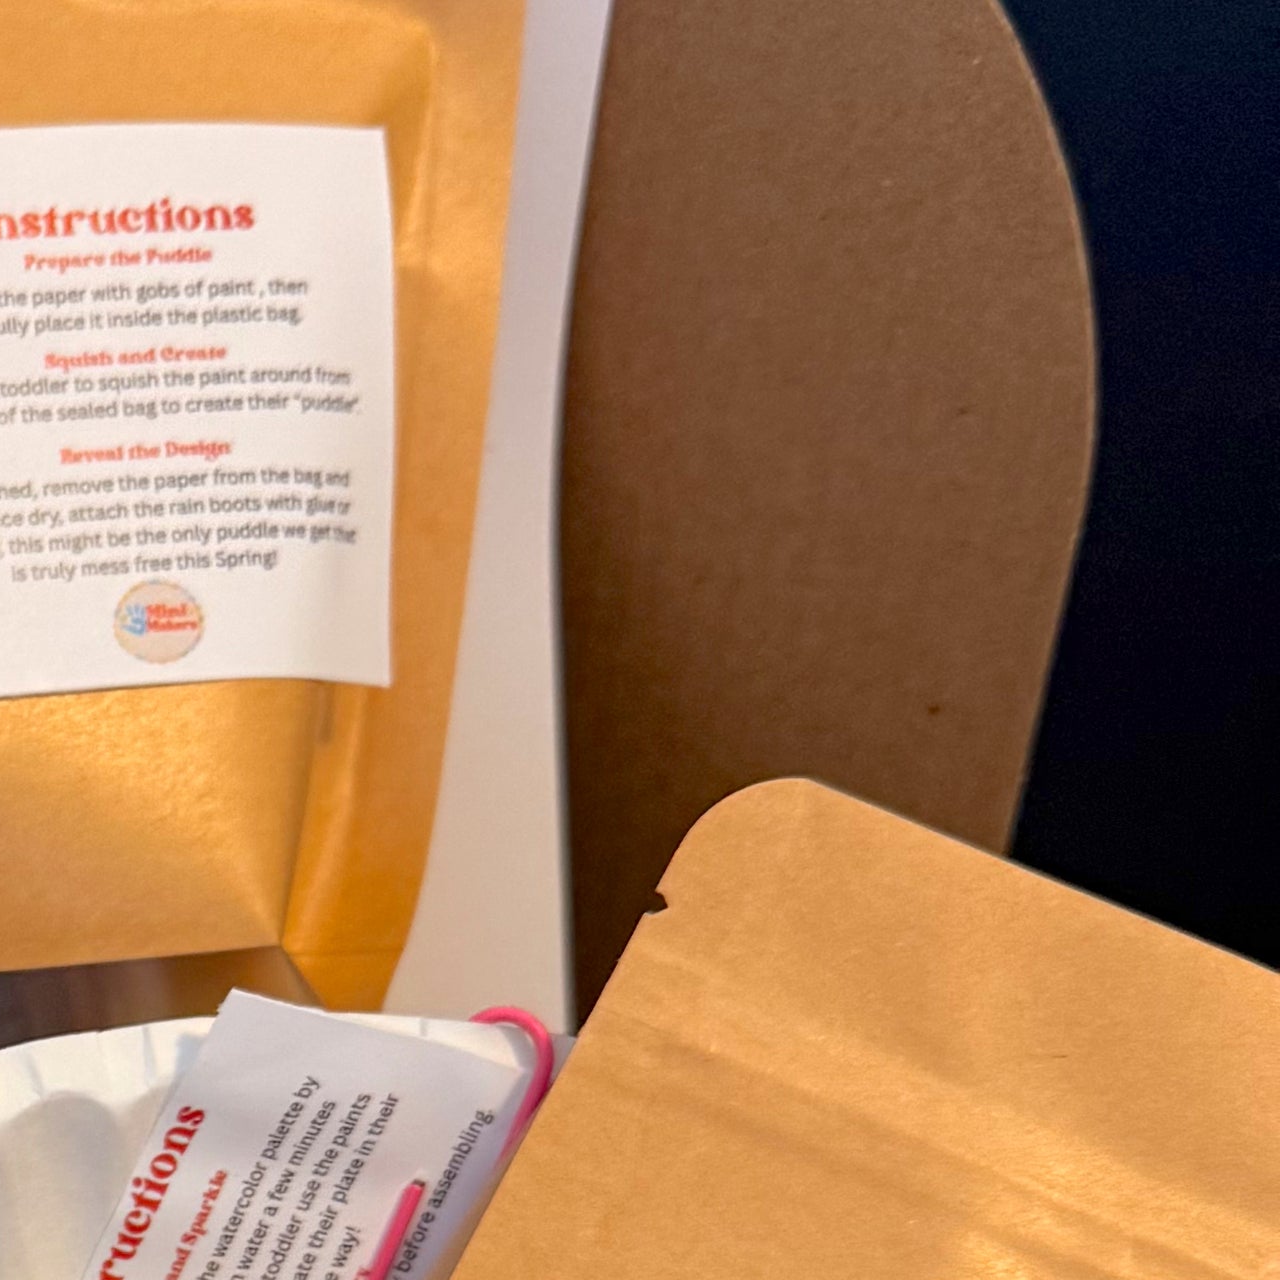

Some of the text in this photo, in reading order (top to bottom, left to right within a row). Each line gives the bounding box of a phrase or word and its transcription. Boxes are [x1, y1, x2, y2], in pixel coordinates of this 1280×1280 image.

[211, 1161, 268, 1258] watercolor
[260, 1101, 305, 1161] palette
[292, 1075, 321, 1099] by
[295, 1179, 322, 1212] use
[311, 1148, 339, 1177] the
[331, 1093, 372, 1148] paints
[180, 1169, 228, 1246] Sparkle
[331, 1225, 361, 1268] way!
